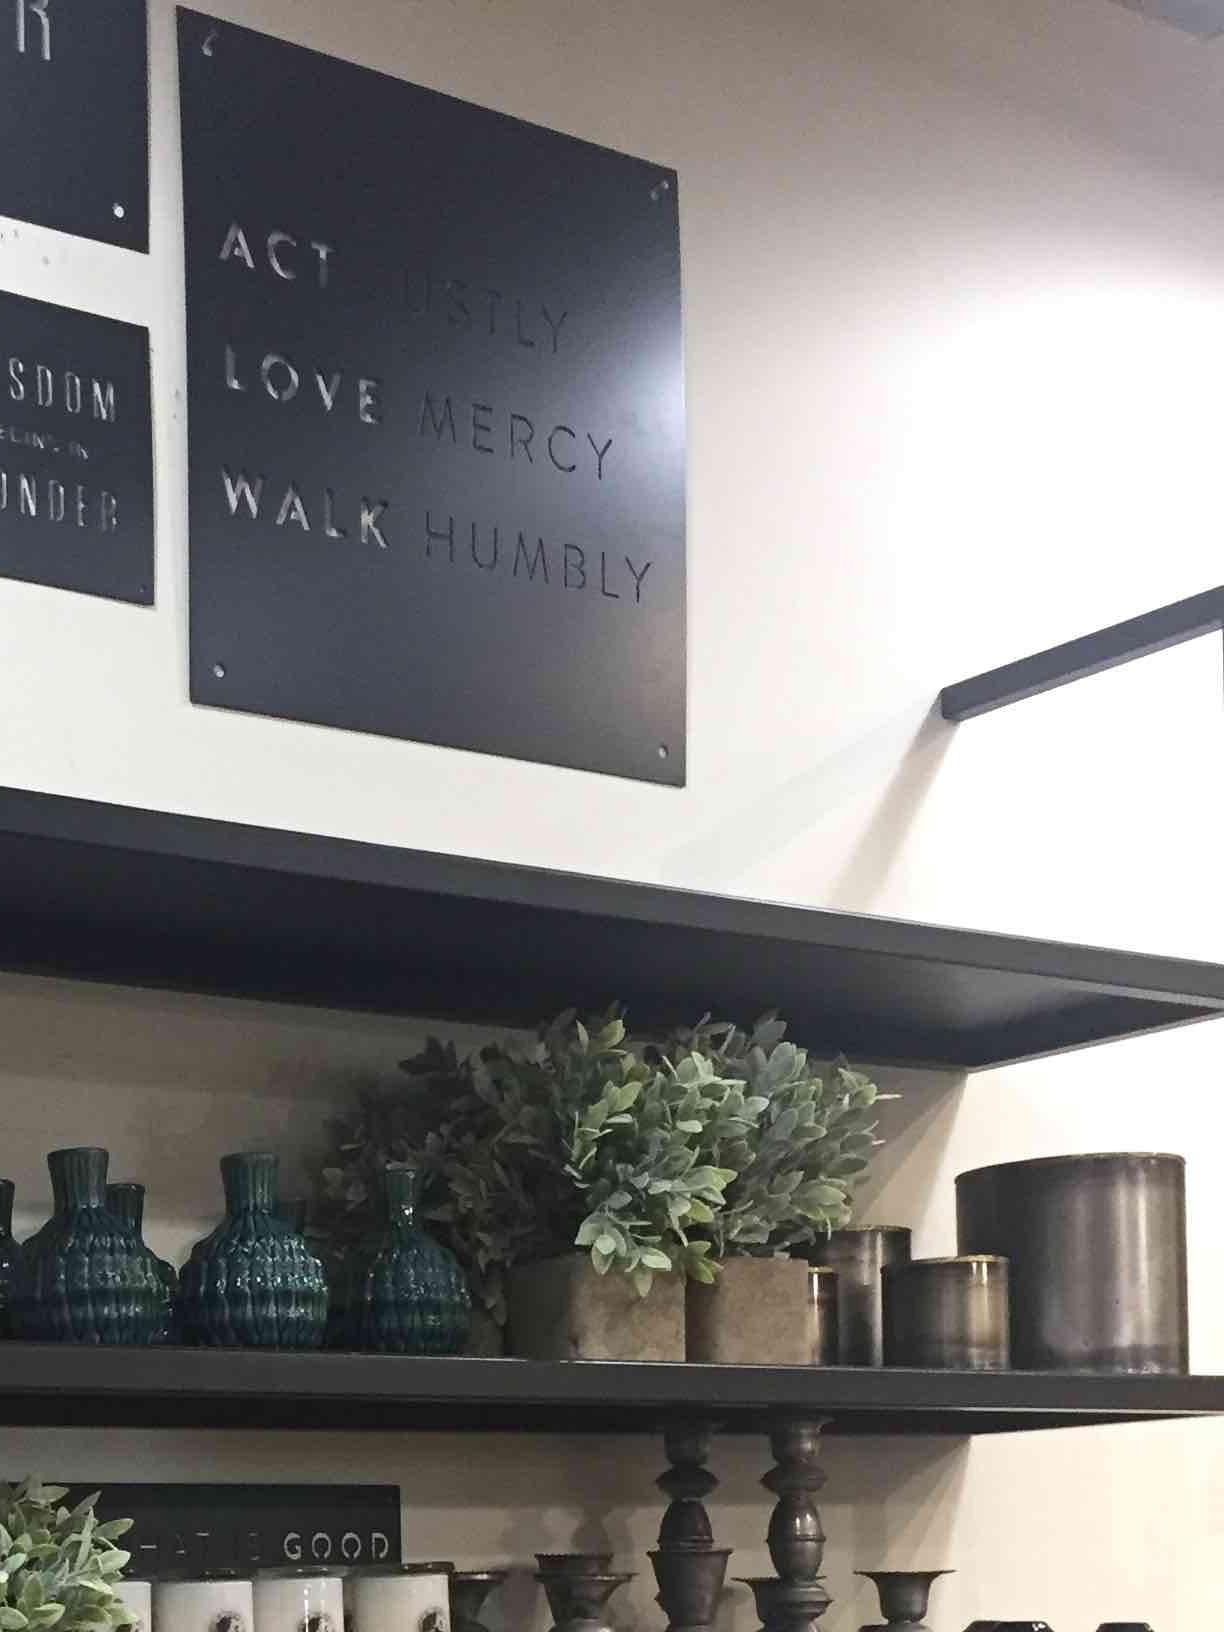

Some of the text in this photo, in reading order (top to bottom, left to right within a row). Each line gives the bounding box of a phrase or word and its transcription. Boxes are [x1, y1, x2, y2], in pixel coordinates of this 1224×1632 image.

[219, 221, 569, 353] ACT USTLY
[224, 342, 613, 481] LOVE MERCY
[222, 463, 652, 603] WALK HUMBLY
[283, 1531, 390, 1562] GOOD
